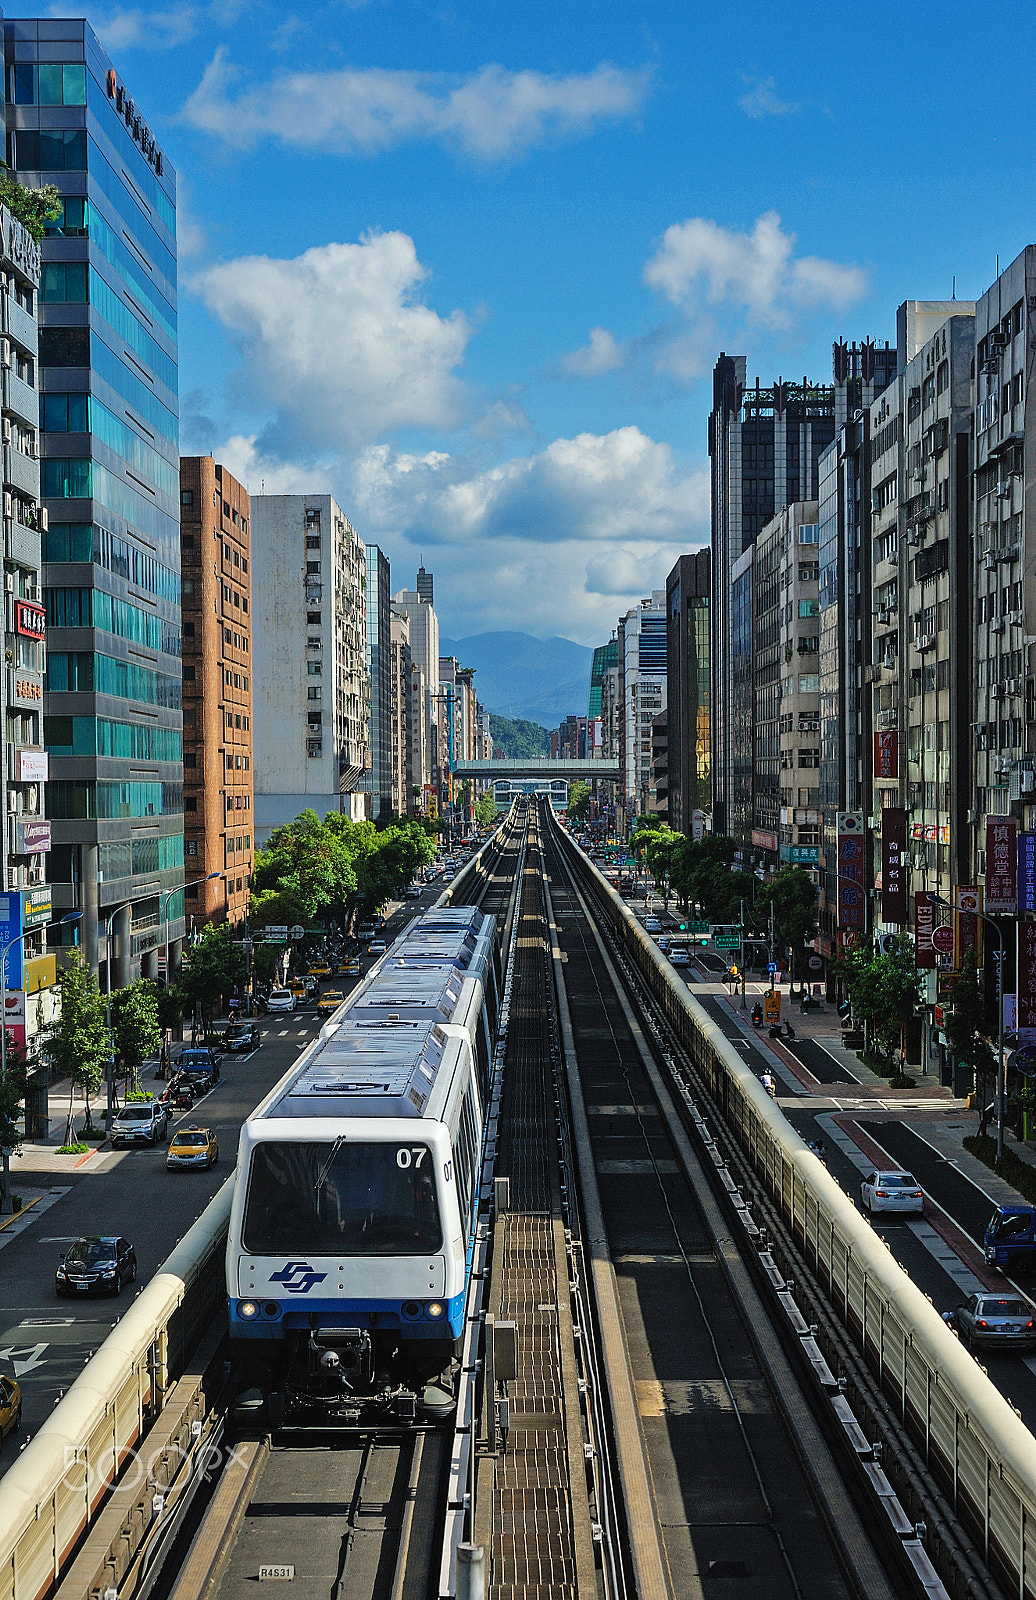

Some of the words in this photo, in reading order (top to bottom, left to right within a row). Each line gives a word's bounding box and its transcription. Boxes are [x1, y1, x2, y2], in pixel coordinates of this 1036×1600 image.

[993, 825, 1010, 876] 慎德堂
[839, 839, 859, 906] 慶州館
[990, 877, 1001, 897] 診所
[917, 905, 933, 951] EDWIN
[396, 1148, 427, 1169] 07
[443, 1159, 453, 1182] 07
[261, 1567, 292, 1578] R4S31
